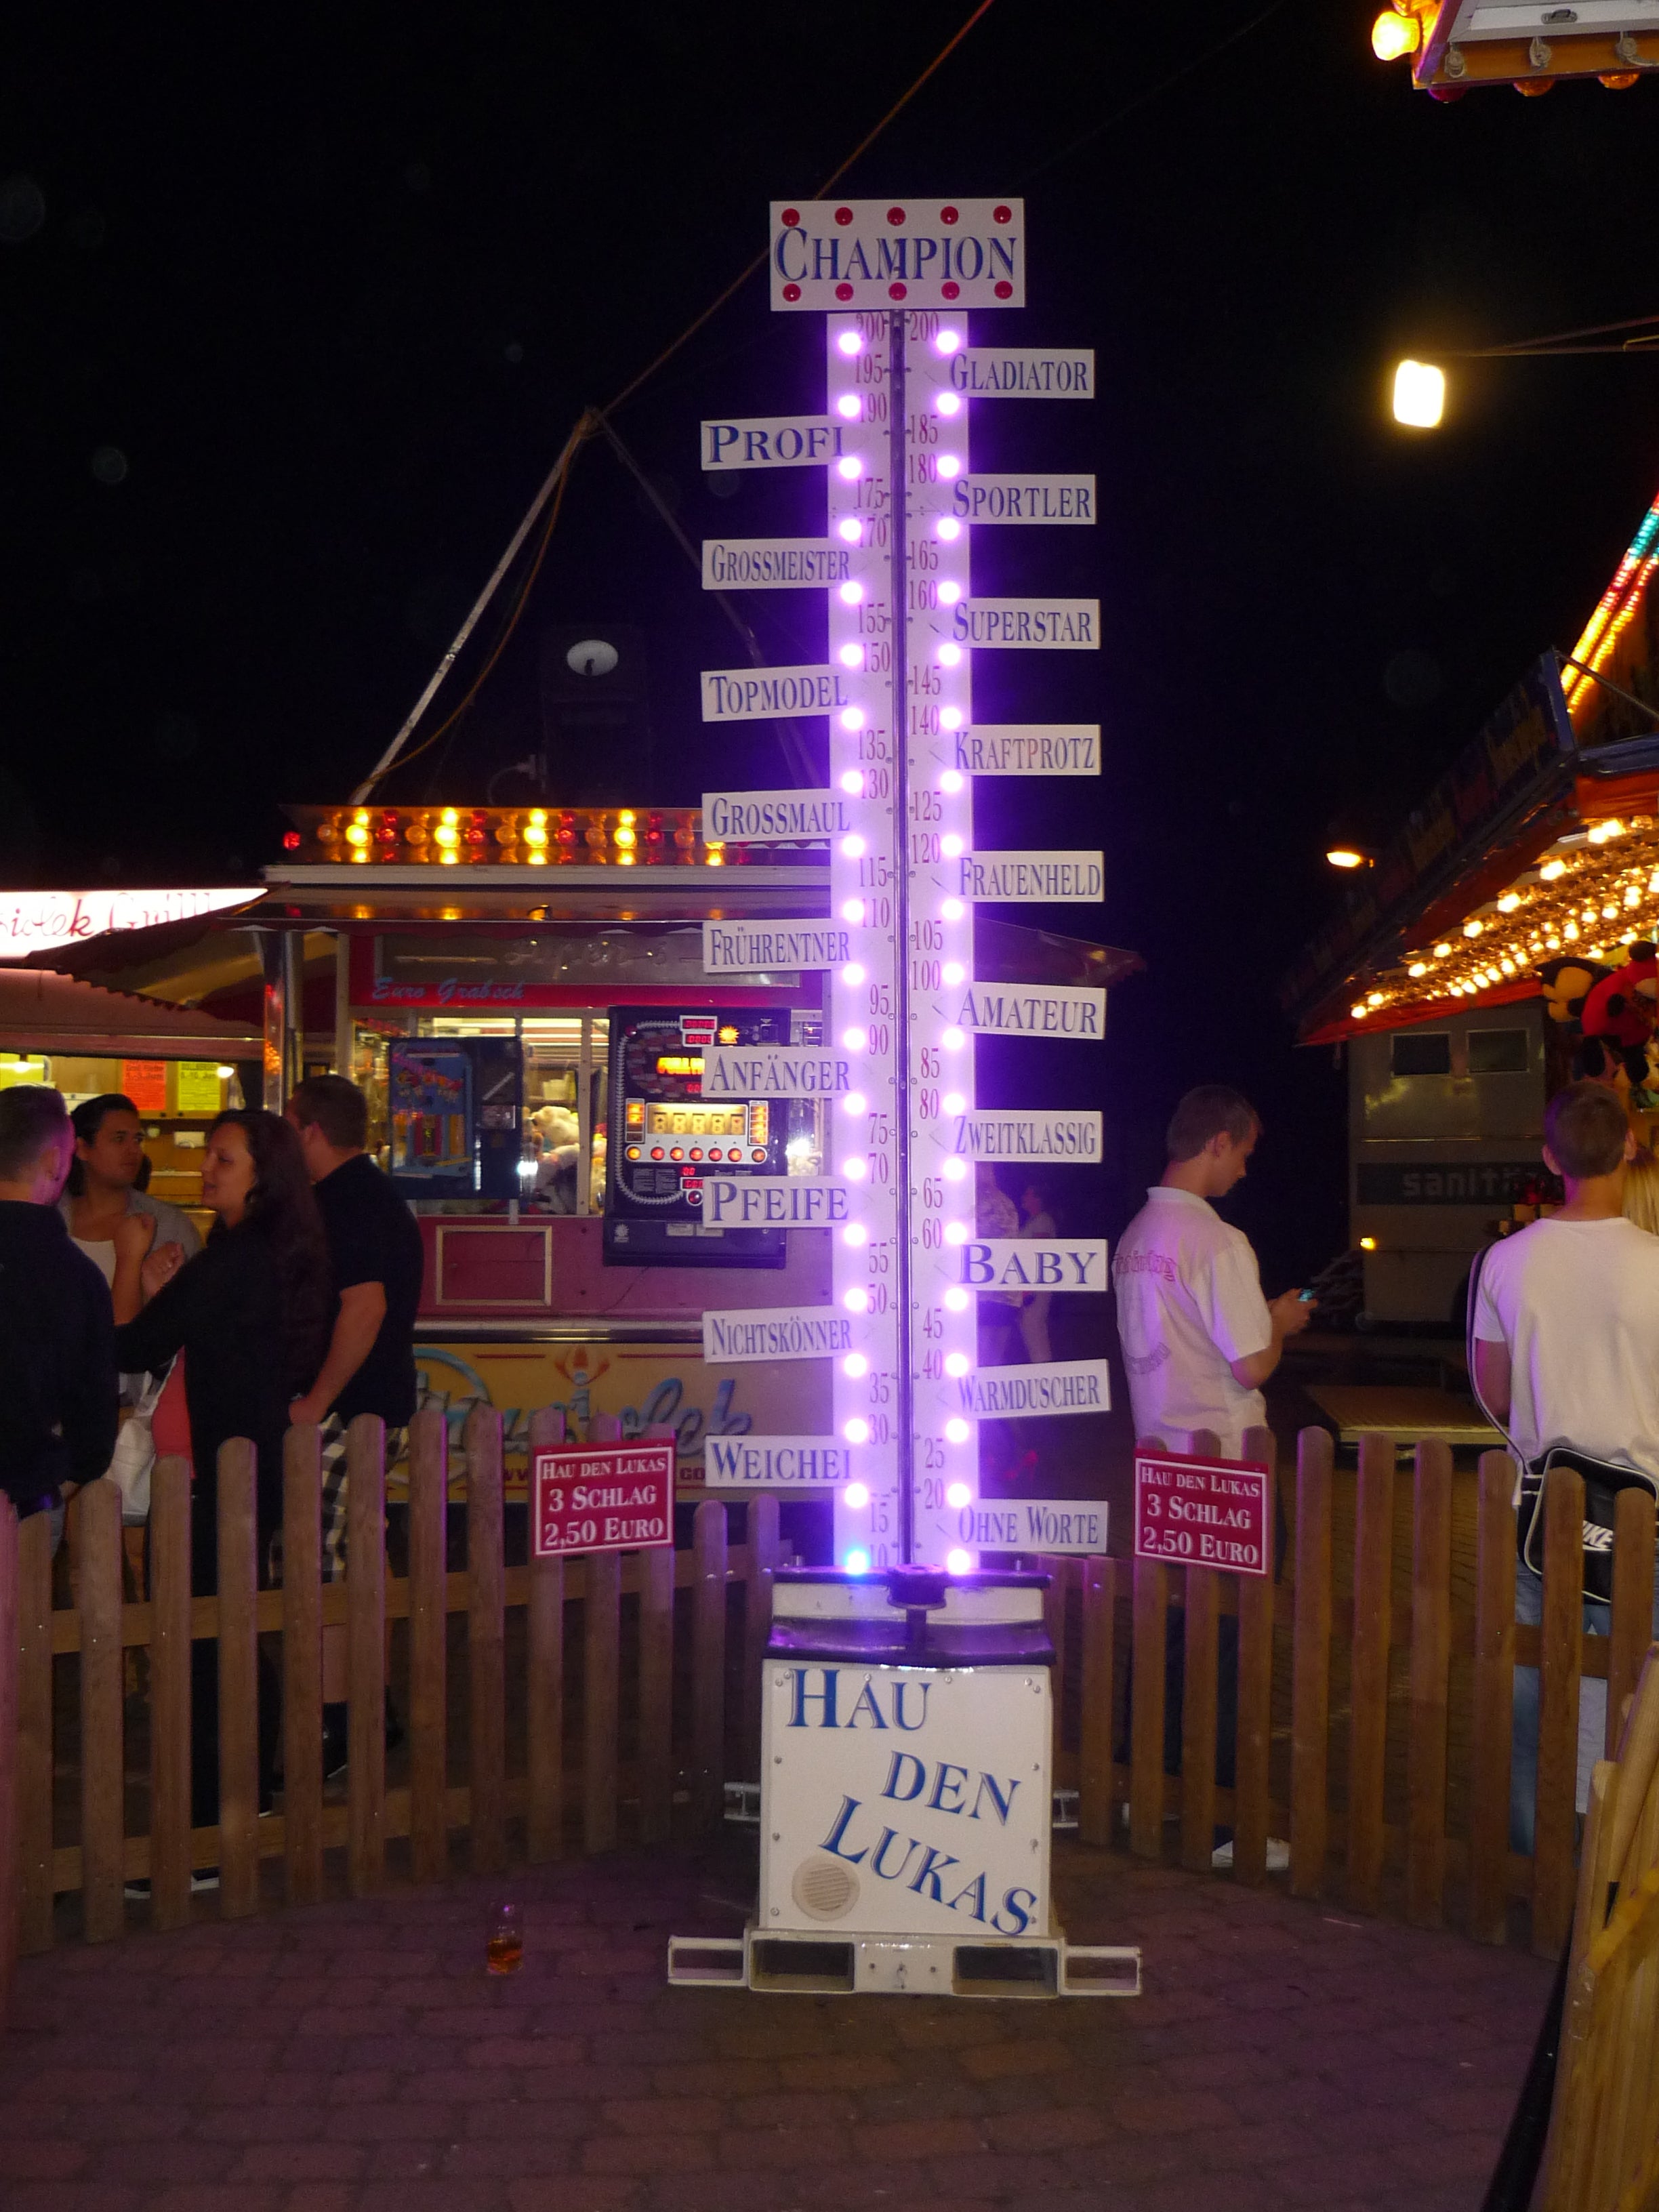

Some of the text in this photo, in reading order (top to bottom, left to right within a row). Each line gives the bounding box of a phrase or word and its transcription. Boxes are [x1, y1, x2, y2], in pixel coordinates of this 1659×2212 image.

[774, 227, 1017, 281] CHAMPION
[910, 312, 939, 341] 200
[856, 354, 882, 384] 195
[951, 353, 1088, 391] GLADIATOR
[705, 425, 844, 463] PROFI
[911, 414, 938, 444] 185
[909, 453, 937, 483] 180
[857, 478, 885, 508] 175
[953, 480, 1092, 518] SPORTLER
[712, 544, 850, 582] GROSSMEISTER
[911, 540, 938, 570] 165
[909, 580, 937, 609] 160
[859, 603, 886, 633] 155
[953, 602, 1092, 642] SUPERSTAR
[863, 642, 890, 672] 150
[709, 675, 848, 714] TOPMODEL
[914, 665, 941, 695] 145
[912, 705, 939, 735] 140
[859, 729, 886, 760] 135
[954, 731, 1095, 769] KRAFTPROTZ
[713, 798, 851, 836] GROSSMAUL
[914, 791, 942, 821] 125
[912, 833, 941, 863] 120
[859, 857, 886, 886] 115
[958, 857, 1101, 896] FRAUENHELD
[710, 926, 851, 965] FRÜHRENTNER
[914, 920, 943, 950] 105
[912, 960, 941, 991] 100
[869, 984, 888, 1015] 95
[956, 988, 1097, 1033] AMATEUR
[869, 1025, 888, 1055] 90
[710, 1054, 851, 1091] ANFÄNGER
[921, 1047, 940, 1078] 85
[920, 1088, 939, 1120] 80
[868, 1113, 888, 1144] 75
[954, 1115, 1096, 1154] ZWEITKLASSIG
[868, 1153, 888, 1184] 70
[710, 1181, 848, 1221] PFEIFE
[924, 1177, 943, 1208] 65
[922, 1218, 942, 1249] 60
[869, 1242, 888, 1273] 55
[958, 1244, 1098, 1284] BABY
[867, 1283, 887, 1314] 50
[712, 1316, 853, 1355] NICHTSKÖNNER
[922, 1307, 943, 1338] 45
[922, 1348, 943, 1379] 40
[869, 1372, 888, 1403] 35
[958, 1374, 1101, 1412] WARMDUSCHER
[868, 1414, 888, 1444] 30
[541, 1461, 576, 1479] HAU
[580, 1461, 611, 1477] DEN
[616, 1457, 667, 1475] LUKAS
[710, 1441, 851, 1480] WEICHEI
[924, 1437, 944, 1468] 25
[924, 1478, 944, 1509] 20
[1141, 1466, 1261, 1497] HAU DEN LUKAS
[548, 1485, 657, 1512] 3 SCHLAG
[1147, 1493, 1252, 1530] 3 SCHLAG
[544, 1517, 664, 1549] 2,50 EURO
[870, 1502, 888, 1533] 15
[959, 1505, 1099, 1545] OHNE WORTE
[1143, 1525, 1258, 1565] 2,50 EURO
[786, 1668, 932, 1731] HAU
[879, 1750, 1021, 1826] DEN
[819, 1794, 1038, 1936] LUKAS
